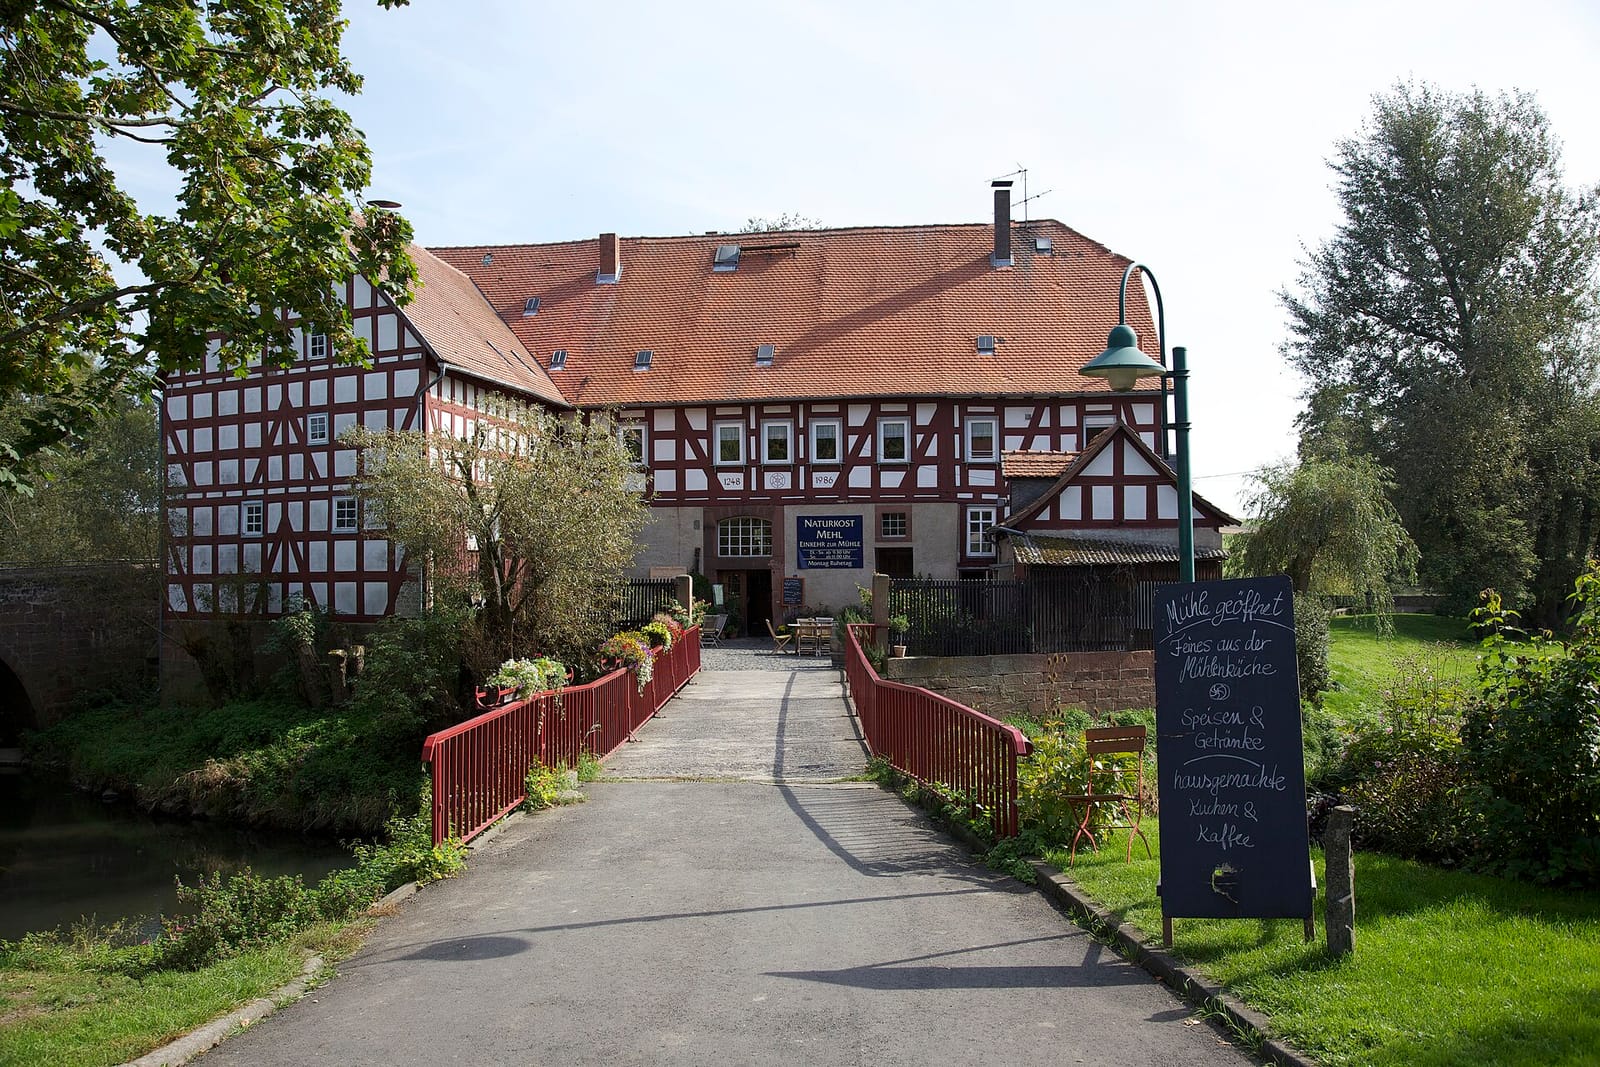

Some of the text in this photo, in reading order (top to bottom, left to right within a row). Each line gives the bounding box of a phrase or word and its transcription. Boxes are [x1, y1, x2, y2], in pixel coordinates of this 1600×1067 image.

[723, 477, 741, 486] 1248
[815, 476, 834, 485] 1986
[804, 520, 855, 528] NATURKOST
[816, 530, 843, 539] MEHL
[1166, 589, 1283, 634] Mühle geöffnet
[1169, 629, 1272, 657] Feines aus der
[1179, 655, 1277, 683] Mühlenküche
[1181, 705, 1265, 730] Speisen &
[1194, 726, 1266, 751] Getränke
[1174, 764, 1287, 796] hausgemachte
[1189, 797, 1258, 822] Kuchen &
[1196, 822, 1255, 850] Kaffee
